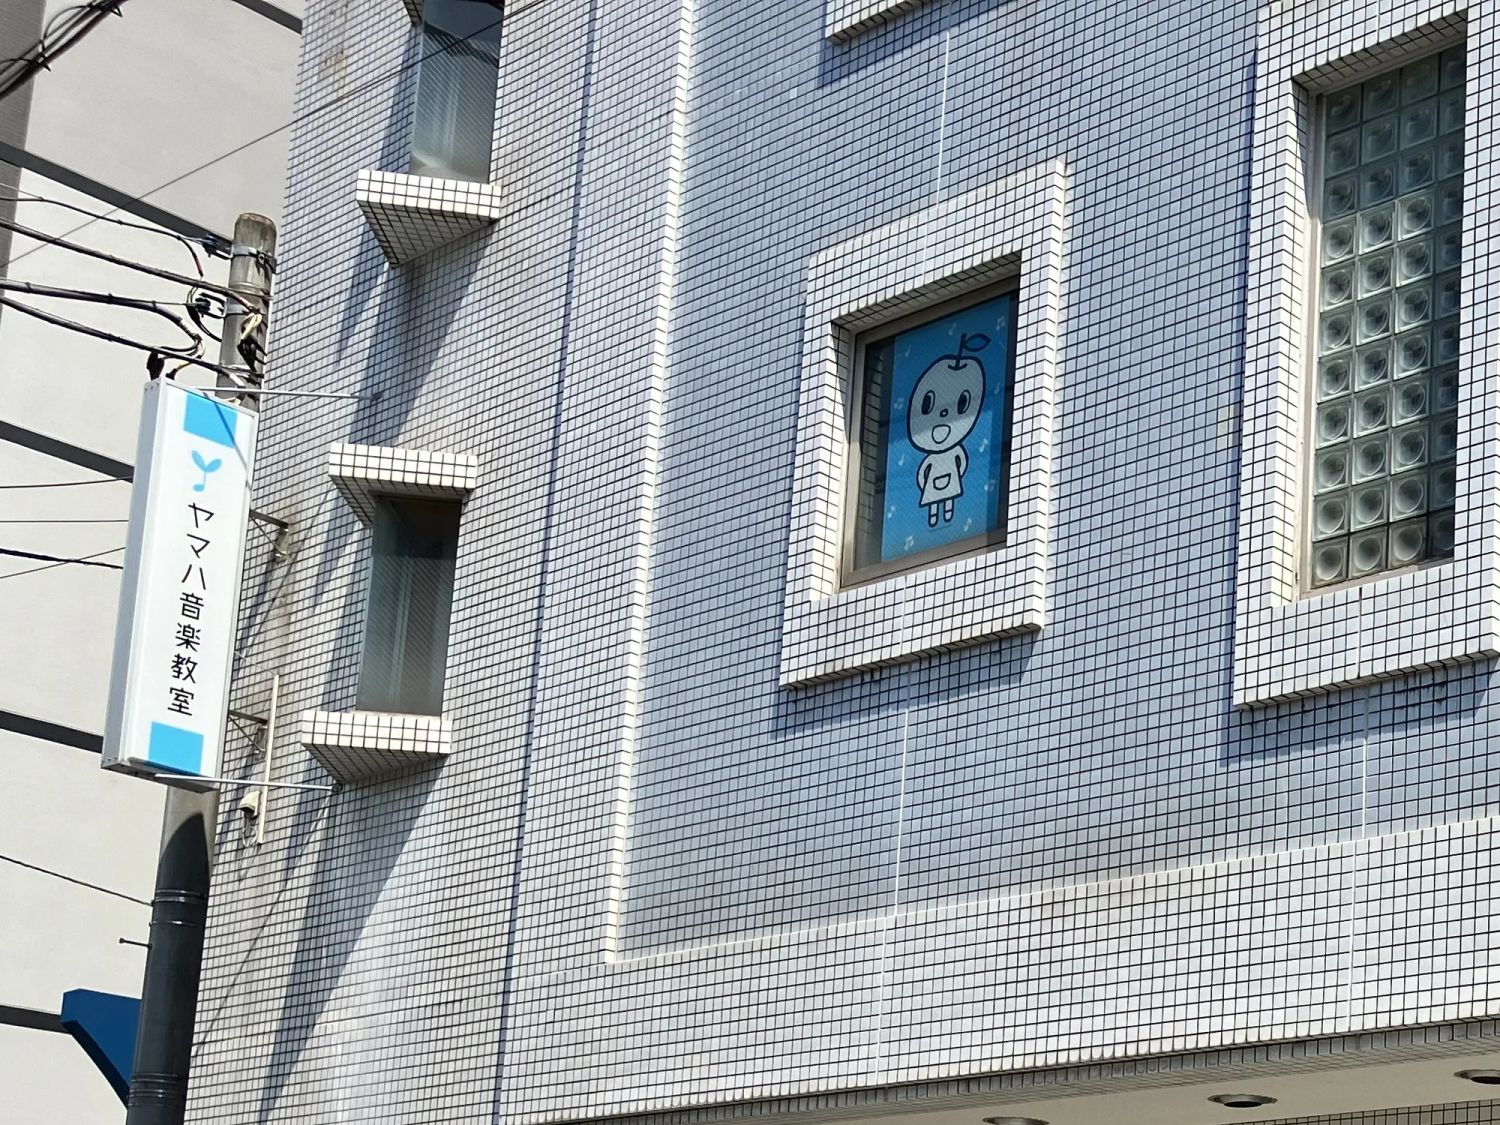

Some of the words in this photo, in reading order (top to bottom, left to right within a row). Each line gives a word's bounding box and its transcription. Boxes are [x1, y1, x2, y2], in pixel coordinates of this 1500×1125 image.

[167, 502, 215, 717] ヤマハ音楽教室
